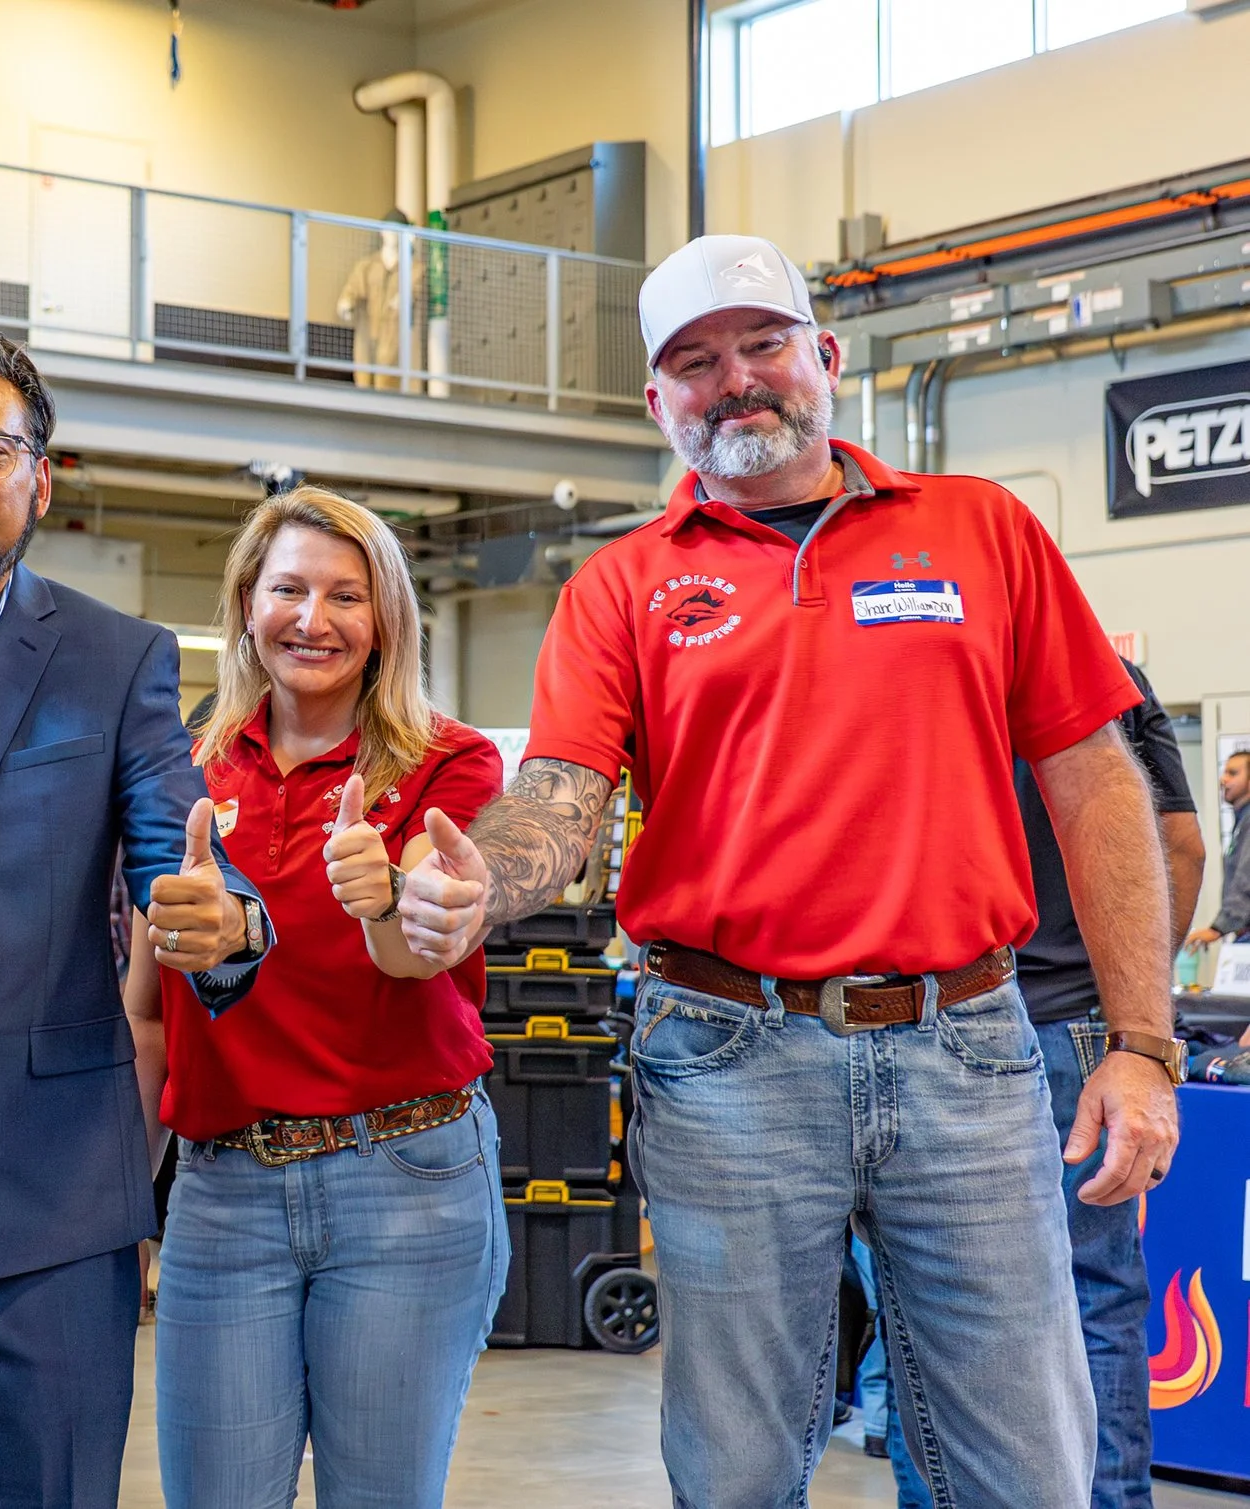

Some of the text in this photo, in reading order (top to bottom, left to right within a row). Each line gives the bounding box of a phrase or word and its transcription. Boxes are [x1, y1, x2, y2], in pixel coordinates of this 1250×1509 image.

[648, 575, 737, 611] TC BOILER
[669, 615, 741, 647] & PIPING
